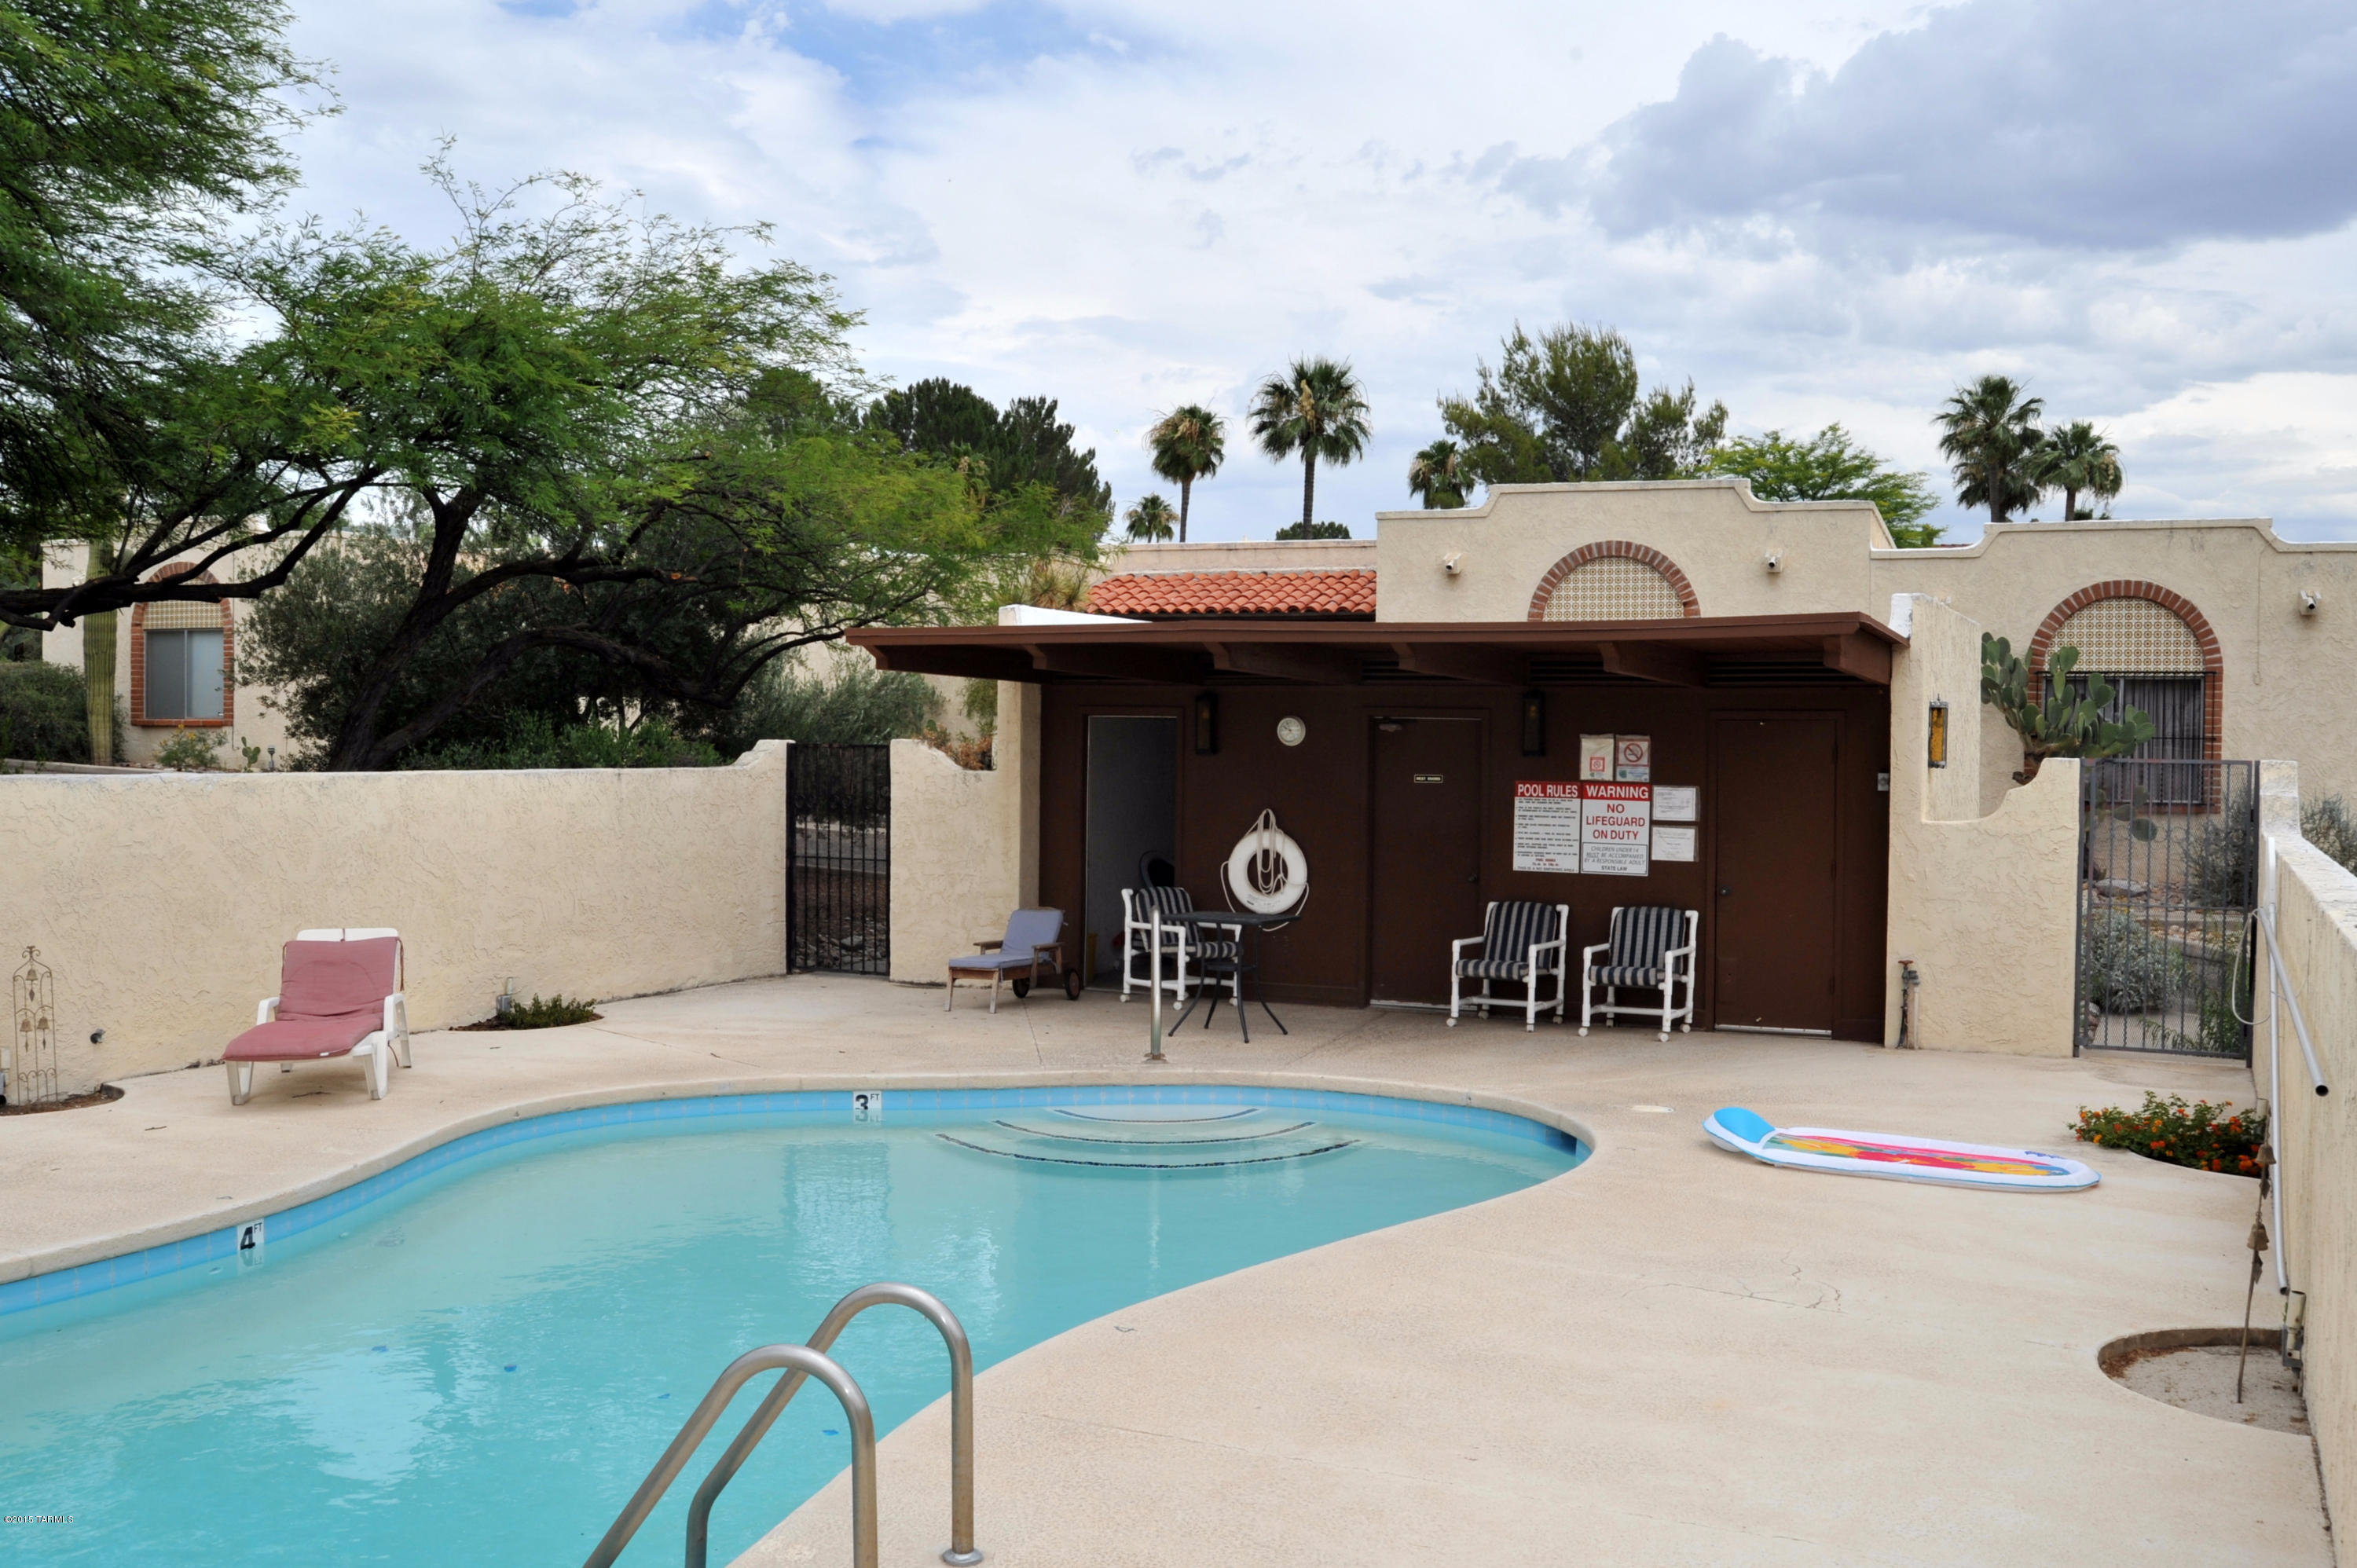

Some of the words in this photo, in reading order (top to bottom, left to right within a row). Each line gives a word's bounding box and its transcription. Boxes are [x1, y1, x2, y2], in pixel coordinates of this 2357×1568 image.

[1518, 784, 1545, 797] POOL
[1547, 785, 1578, 798] RULES
[1586, 785, 1648, 799] WARNING
[1607, 804, 1625, 813] NO
[1586, 815, 1645, 827] LIFEGUARD
[1593, 830, 1607, 839] ON
[1611, 830, 1639, 840] DUTY
[856, 1094, 868, 1110] 3
[240, 1225, 255, 1251] 4
[254, 1222, 262, 1233] FT
